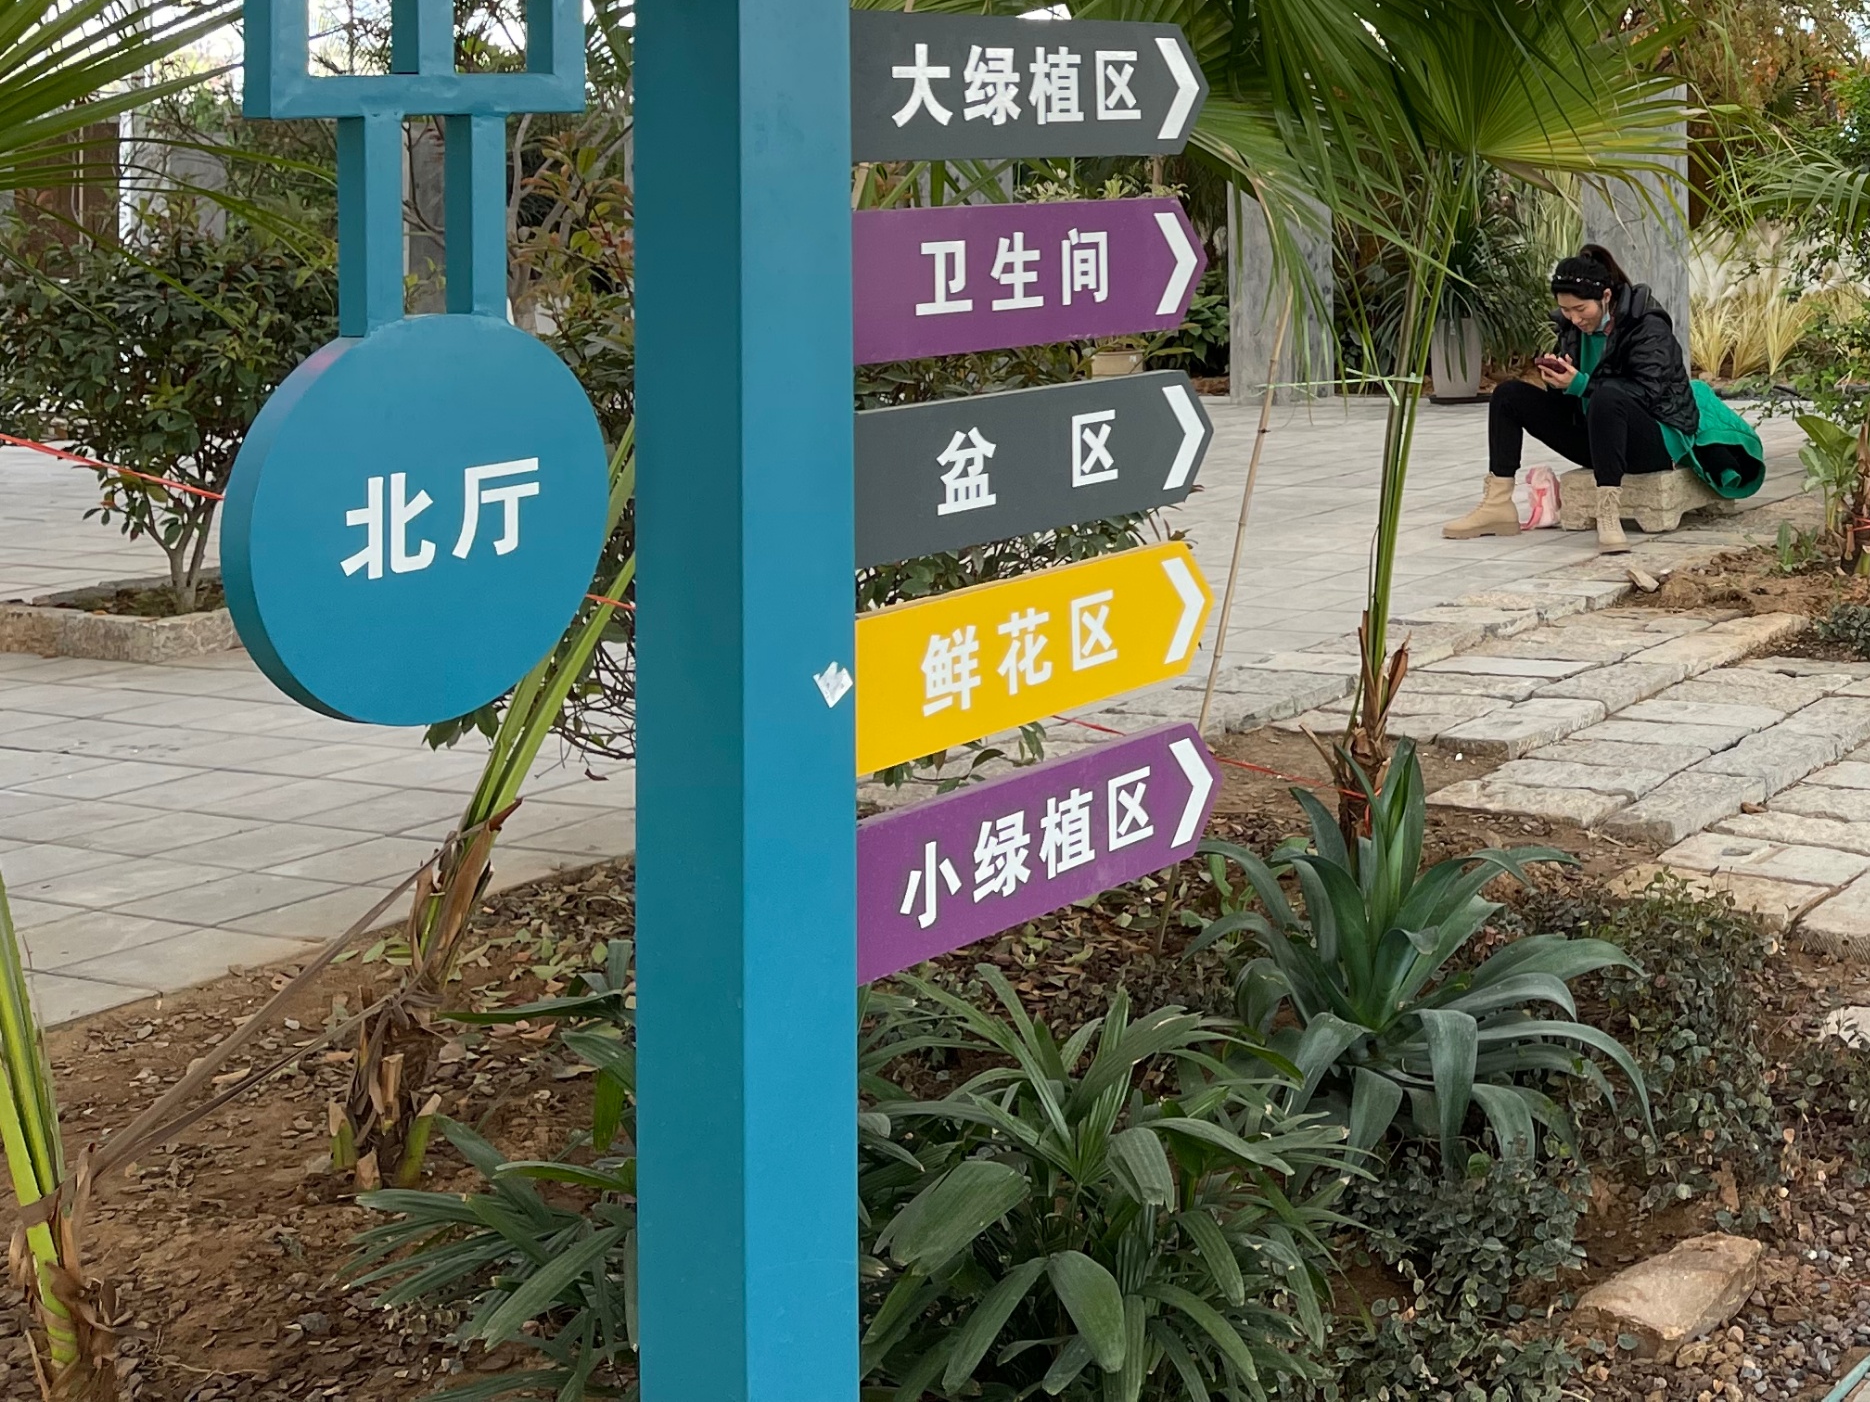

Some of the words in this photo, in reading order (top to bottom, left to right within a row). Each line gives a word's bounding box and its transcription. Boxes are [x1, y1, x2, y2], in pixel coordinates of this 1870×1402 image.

[890, 45, 1143, 129] 大绿植区
[916, 228, 1111, 317] 卫生间
[340, 457, 540, 580] 北厅
[921, 589, 1117, 717] 鲜花区
[900, 766, 1155, 930] 小绿植区
